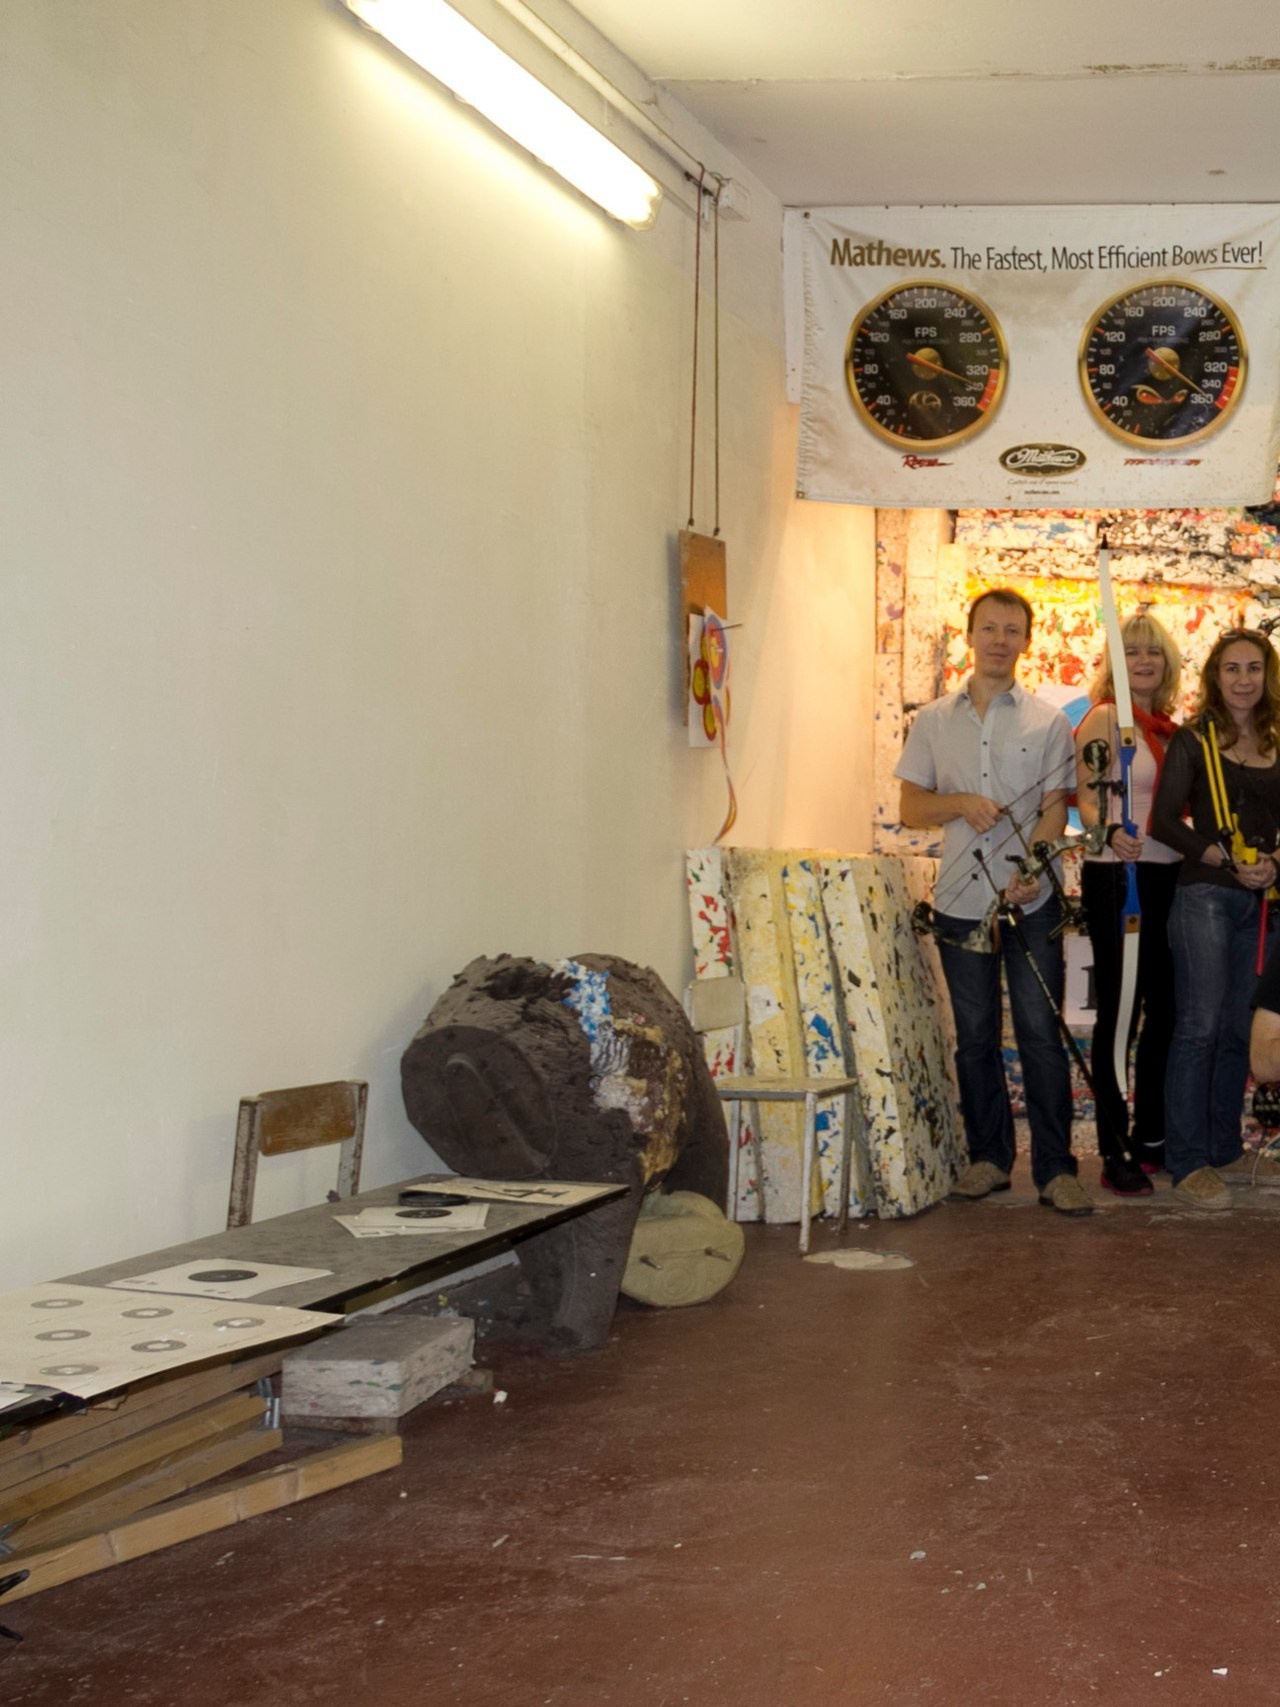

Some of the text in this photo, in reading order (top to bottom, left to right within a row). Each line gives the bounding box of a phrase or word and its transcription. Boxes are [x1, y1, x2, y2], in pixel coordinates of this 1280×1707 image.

[829, 237, 1263, 273] Mathews. The Fastest, Most Efficient Bows Ever!
[913, 298, 937, 309] 200
[1152, 296, 1176, 308] 200
[888, 308, 908, 320] 160
[944, 307, 967, 319] 240
[1124, 306, 1145, 318] 160
[1183, 306, 1207, 318] 240
[914, 326, 938, 338] FPS
[1104, 331, 1126, 343] 120
[1151, 325, 1177, 337] FPS
[1198, 330, 1221, 342] 280
[869, 332, 890, 343] 120
[959, 332, 982, 343] 280
[864, 363, 879, 375] 80
[966, 364, 989, 375] 320
[1099, 364, 1116, 375] 80
[1203, 362, 1228, 373] 320
[1201, 379, 1222, 389] 340
[876, 394, 892, 406] 40
[953, 396, 977, 407] 360
[1112, 395, 1129, 407] 40
